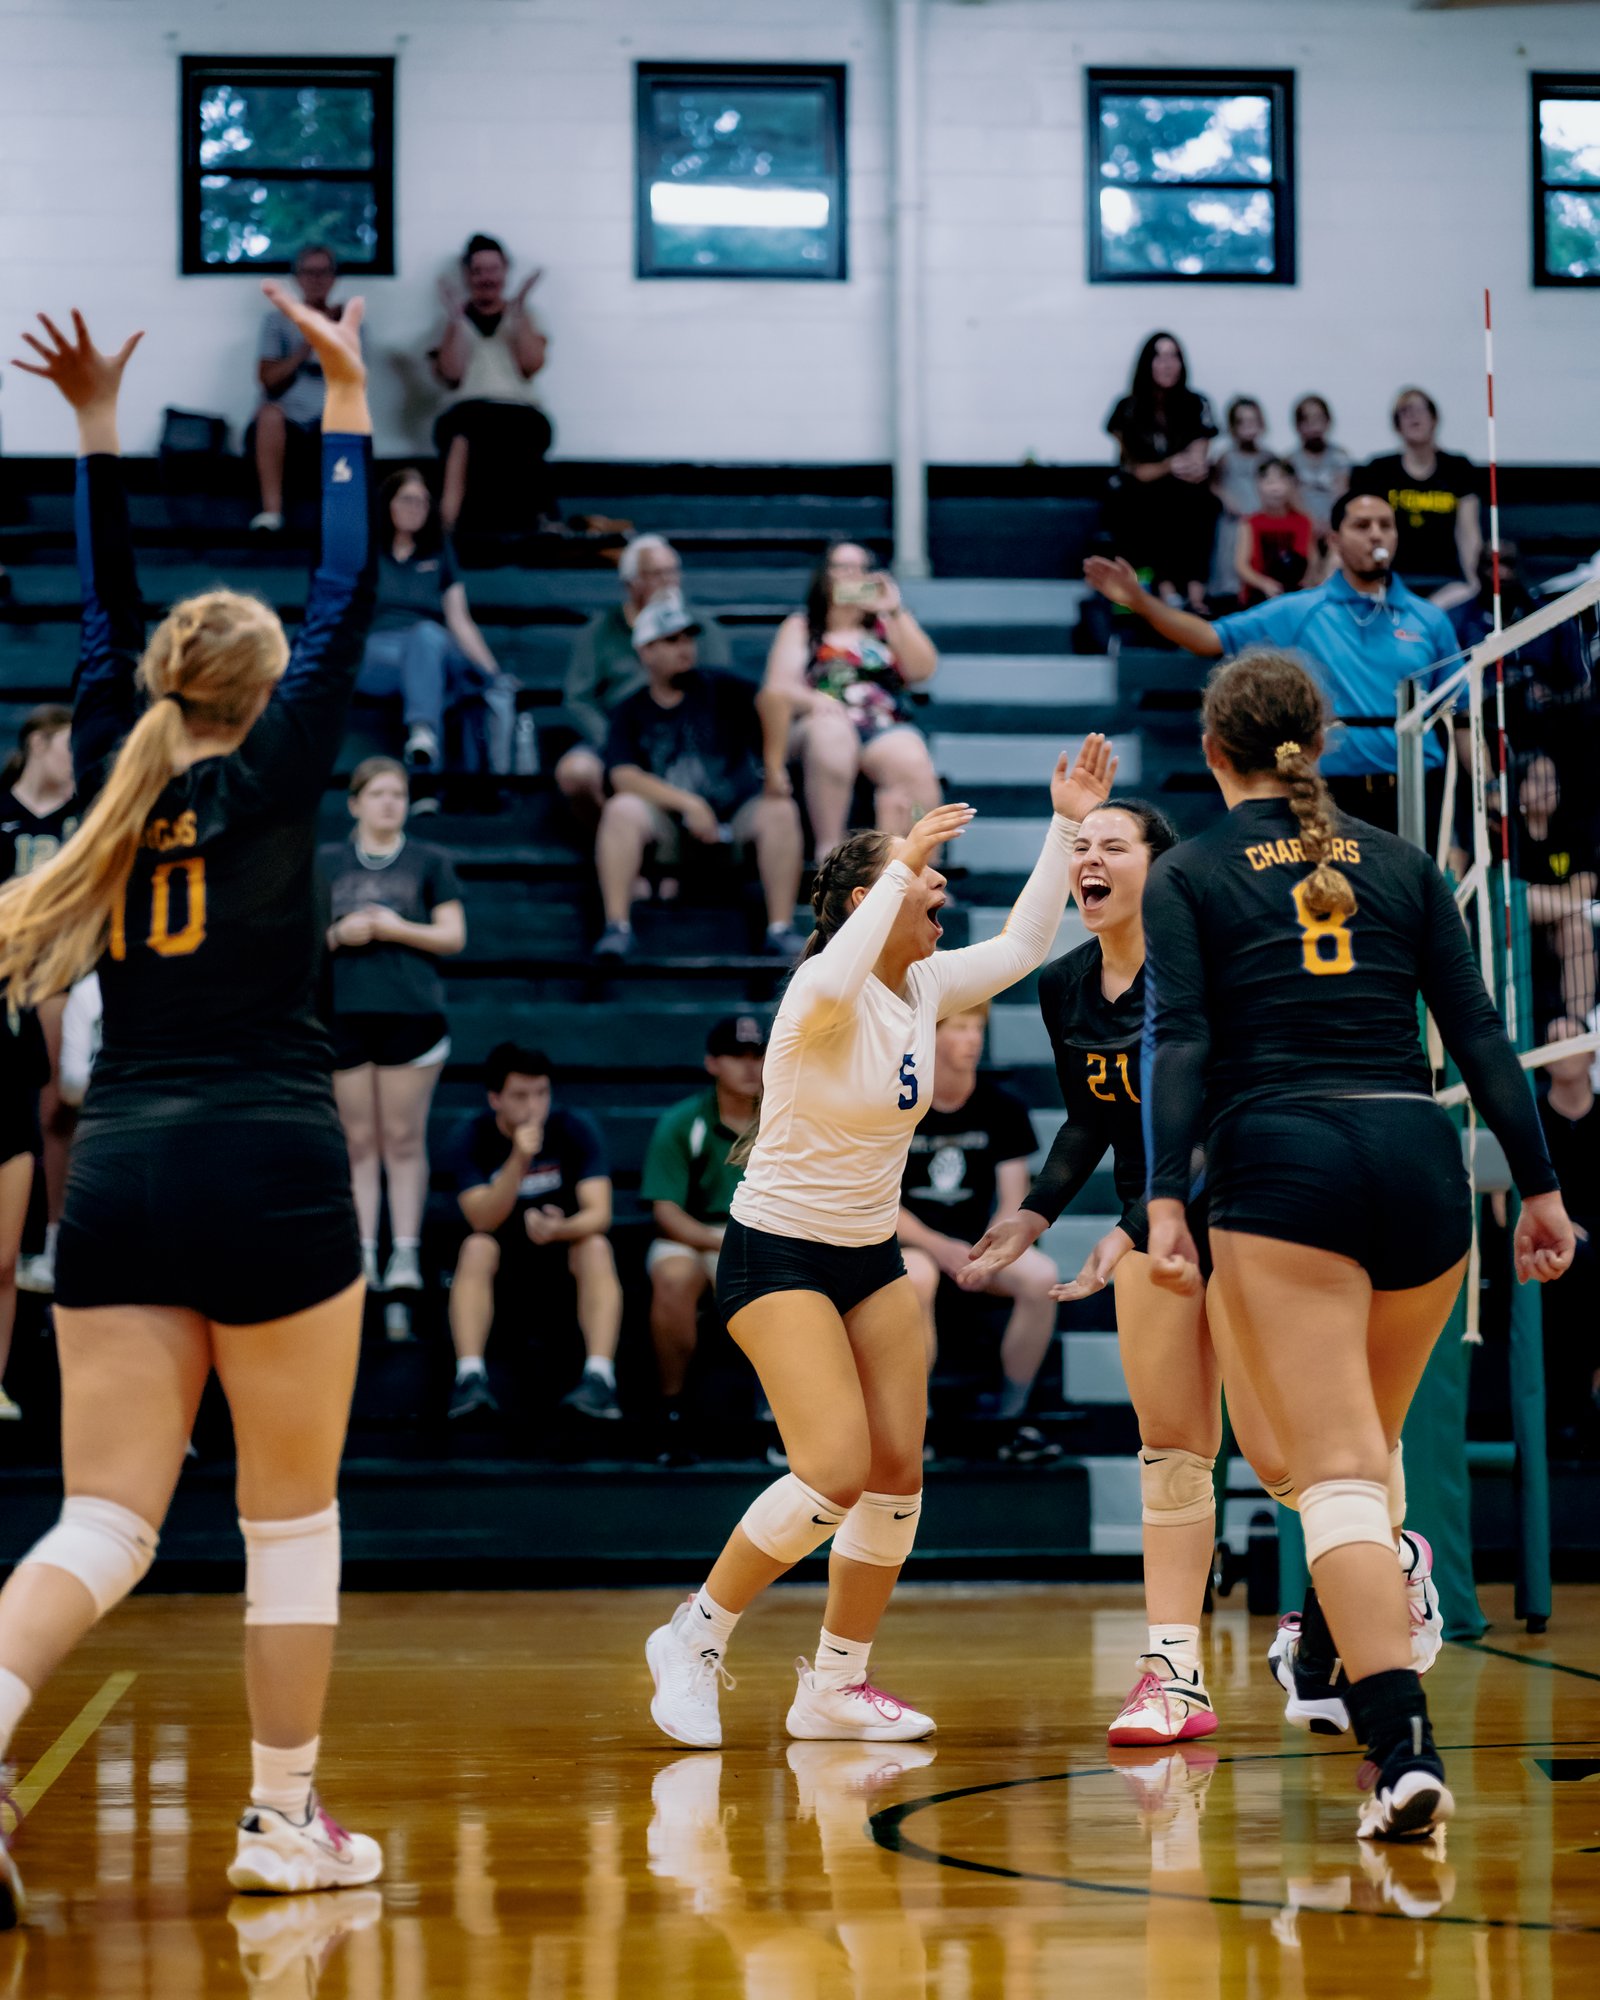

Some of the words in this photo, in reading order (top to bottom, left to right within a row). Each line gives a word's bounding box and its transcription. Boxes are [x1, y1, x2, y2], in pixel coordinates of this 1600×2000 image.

[1245, 837, 1361, 872] CHARRS
[110, 857, 207, 961] 10
[1291, 881, 1355, 976] 8
[898, 1053, 918, 1110] 5
[1087, 1053, 1141, 1103] 21
